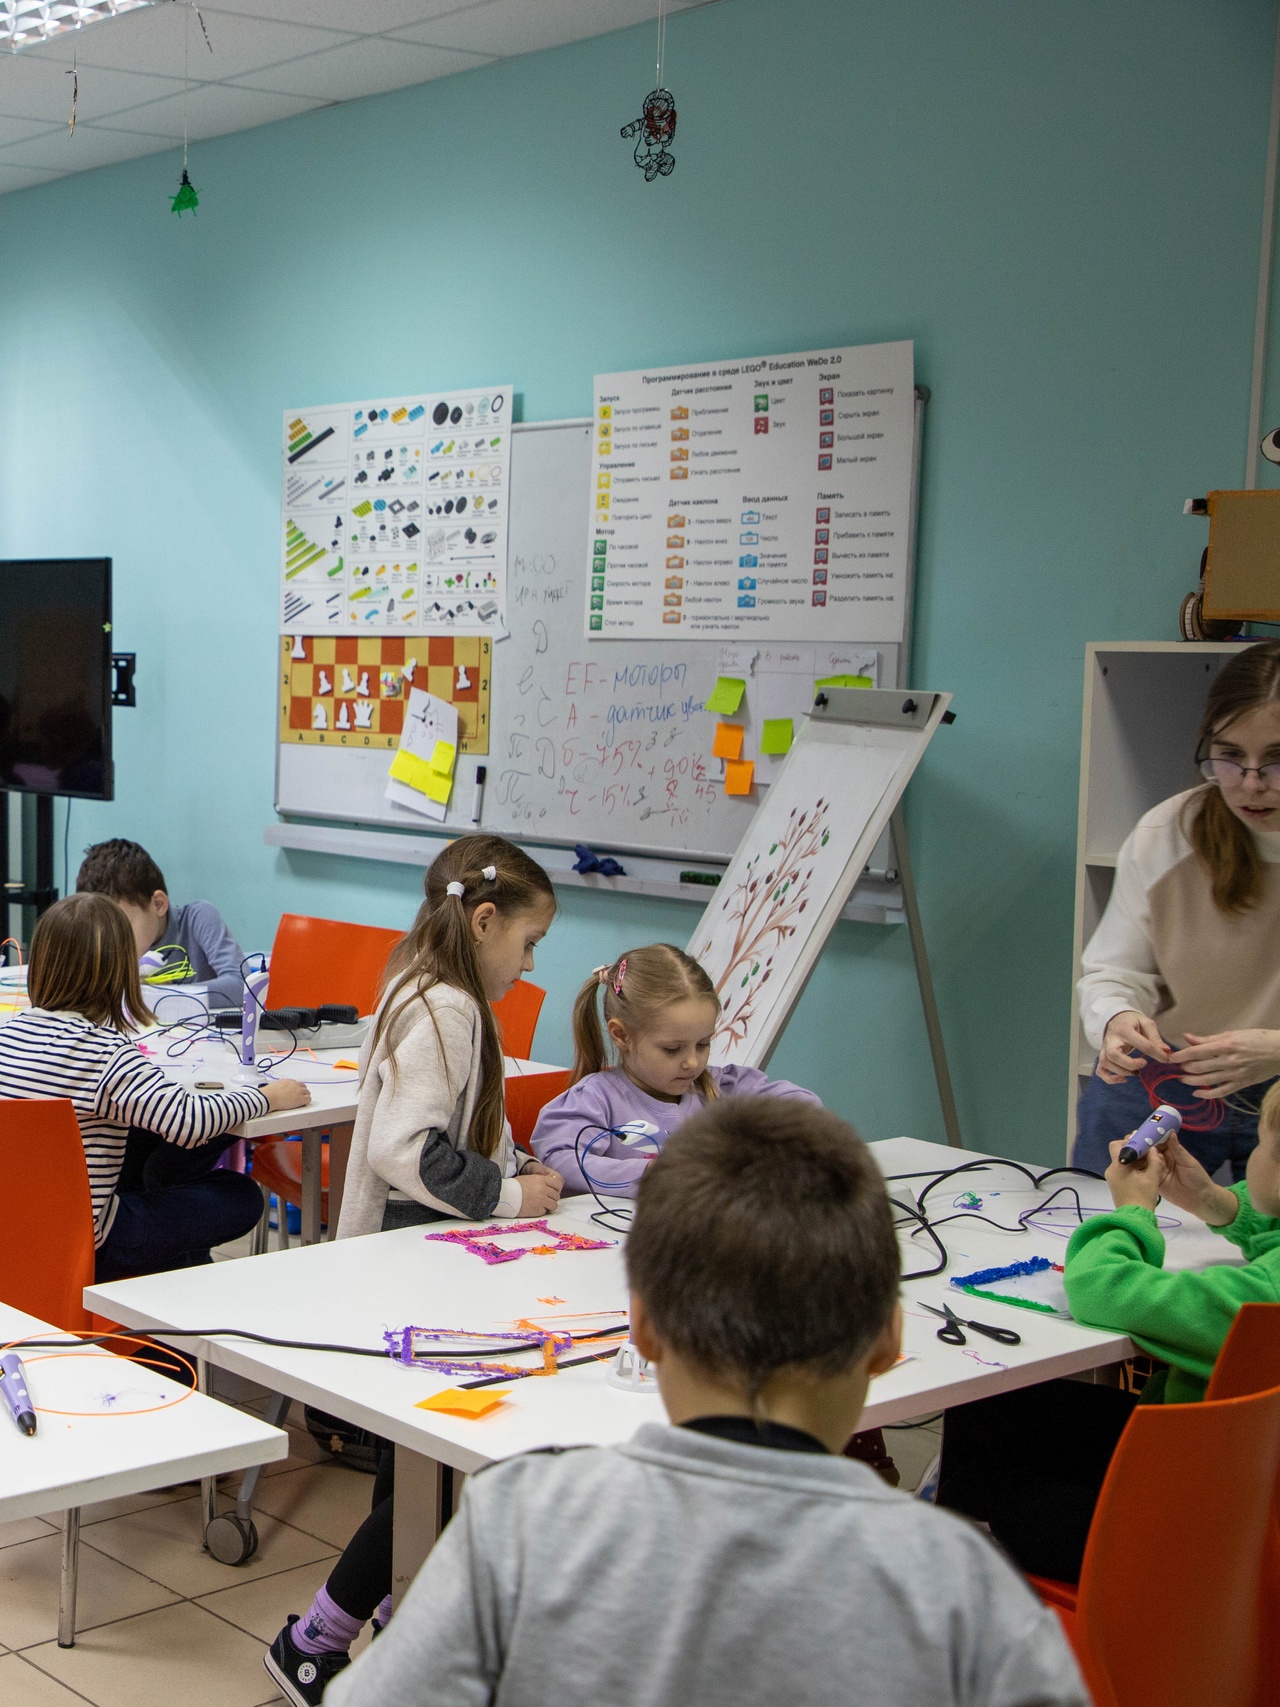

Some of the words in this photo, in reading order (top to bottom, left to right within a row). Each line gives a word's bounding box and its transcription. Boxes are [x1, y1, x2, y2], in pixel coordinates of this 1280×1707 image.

[642, 370, 710, 384] Программирование
[718, 367, 740, 377] среде
[769, 360, 805, 371] Education
[807, 357, 828, 367] WeDo
[830, 355, 842, 365] 2.0
[818, 373, 841, 382] Экран
[753, 380, 770, 388] Звук
[777, 378, 793, 386] цвет
[671, 388, 694, 396] Датчик
[694, 384, 732, 395] расстояния
[599, 395, 620, 403] Запуск
[742, 496, 760, 504] Ввод
[761, 495, 788, 503] данных
[817, 492, 844, 500] Память
[668, 500, 691, 508] Датчик
[691, 498, 718, 506] наклона
[595, 528, 615, 537] Мотор
[285, 642, 290, 652] 3
[484, 643, 489, 654] 3
[284, 674, 288, 685] 2
[482, 680, 488, 690] 2
[283, 705, 287, 715] 1
[481, 714, 486, 724] 1
[606, 702, 675, 748] датчик
[298, 733, 304, 741] A
[320, 734, 324, 742] B
[342, 735, 346, 744] C
[364, 736, 369, 744] D
[388, 738, 392, 746] E
[462, 742, 468, 750] H
